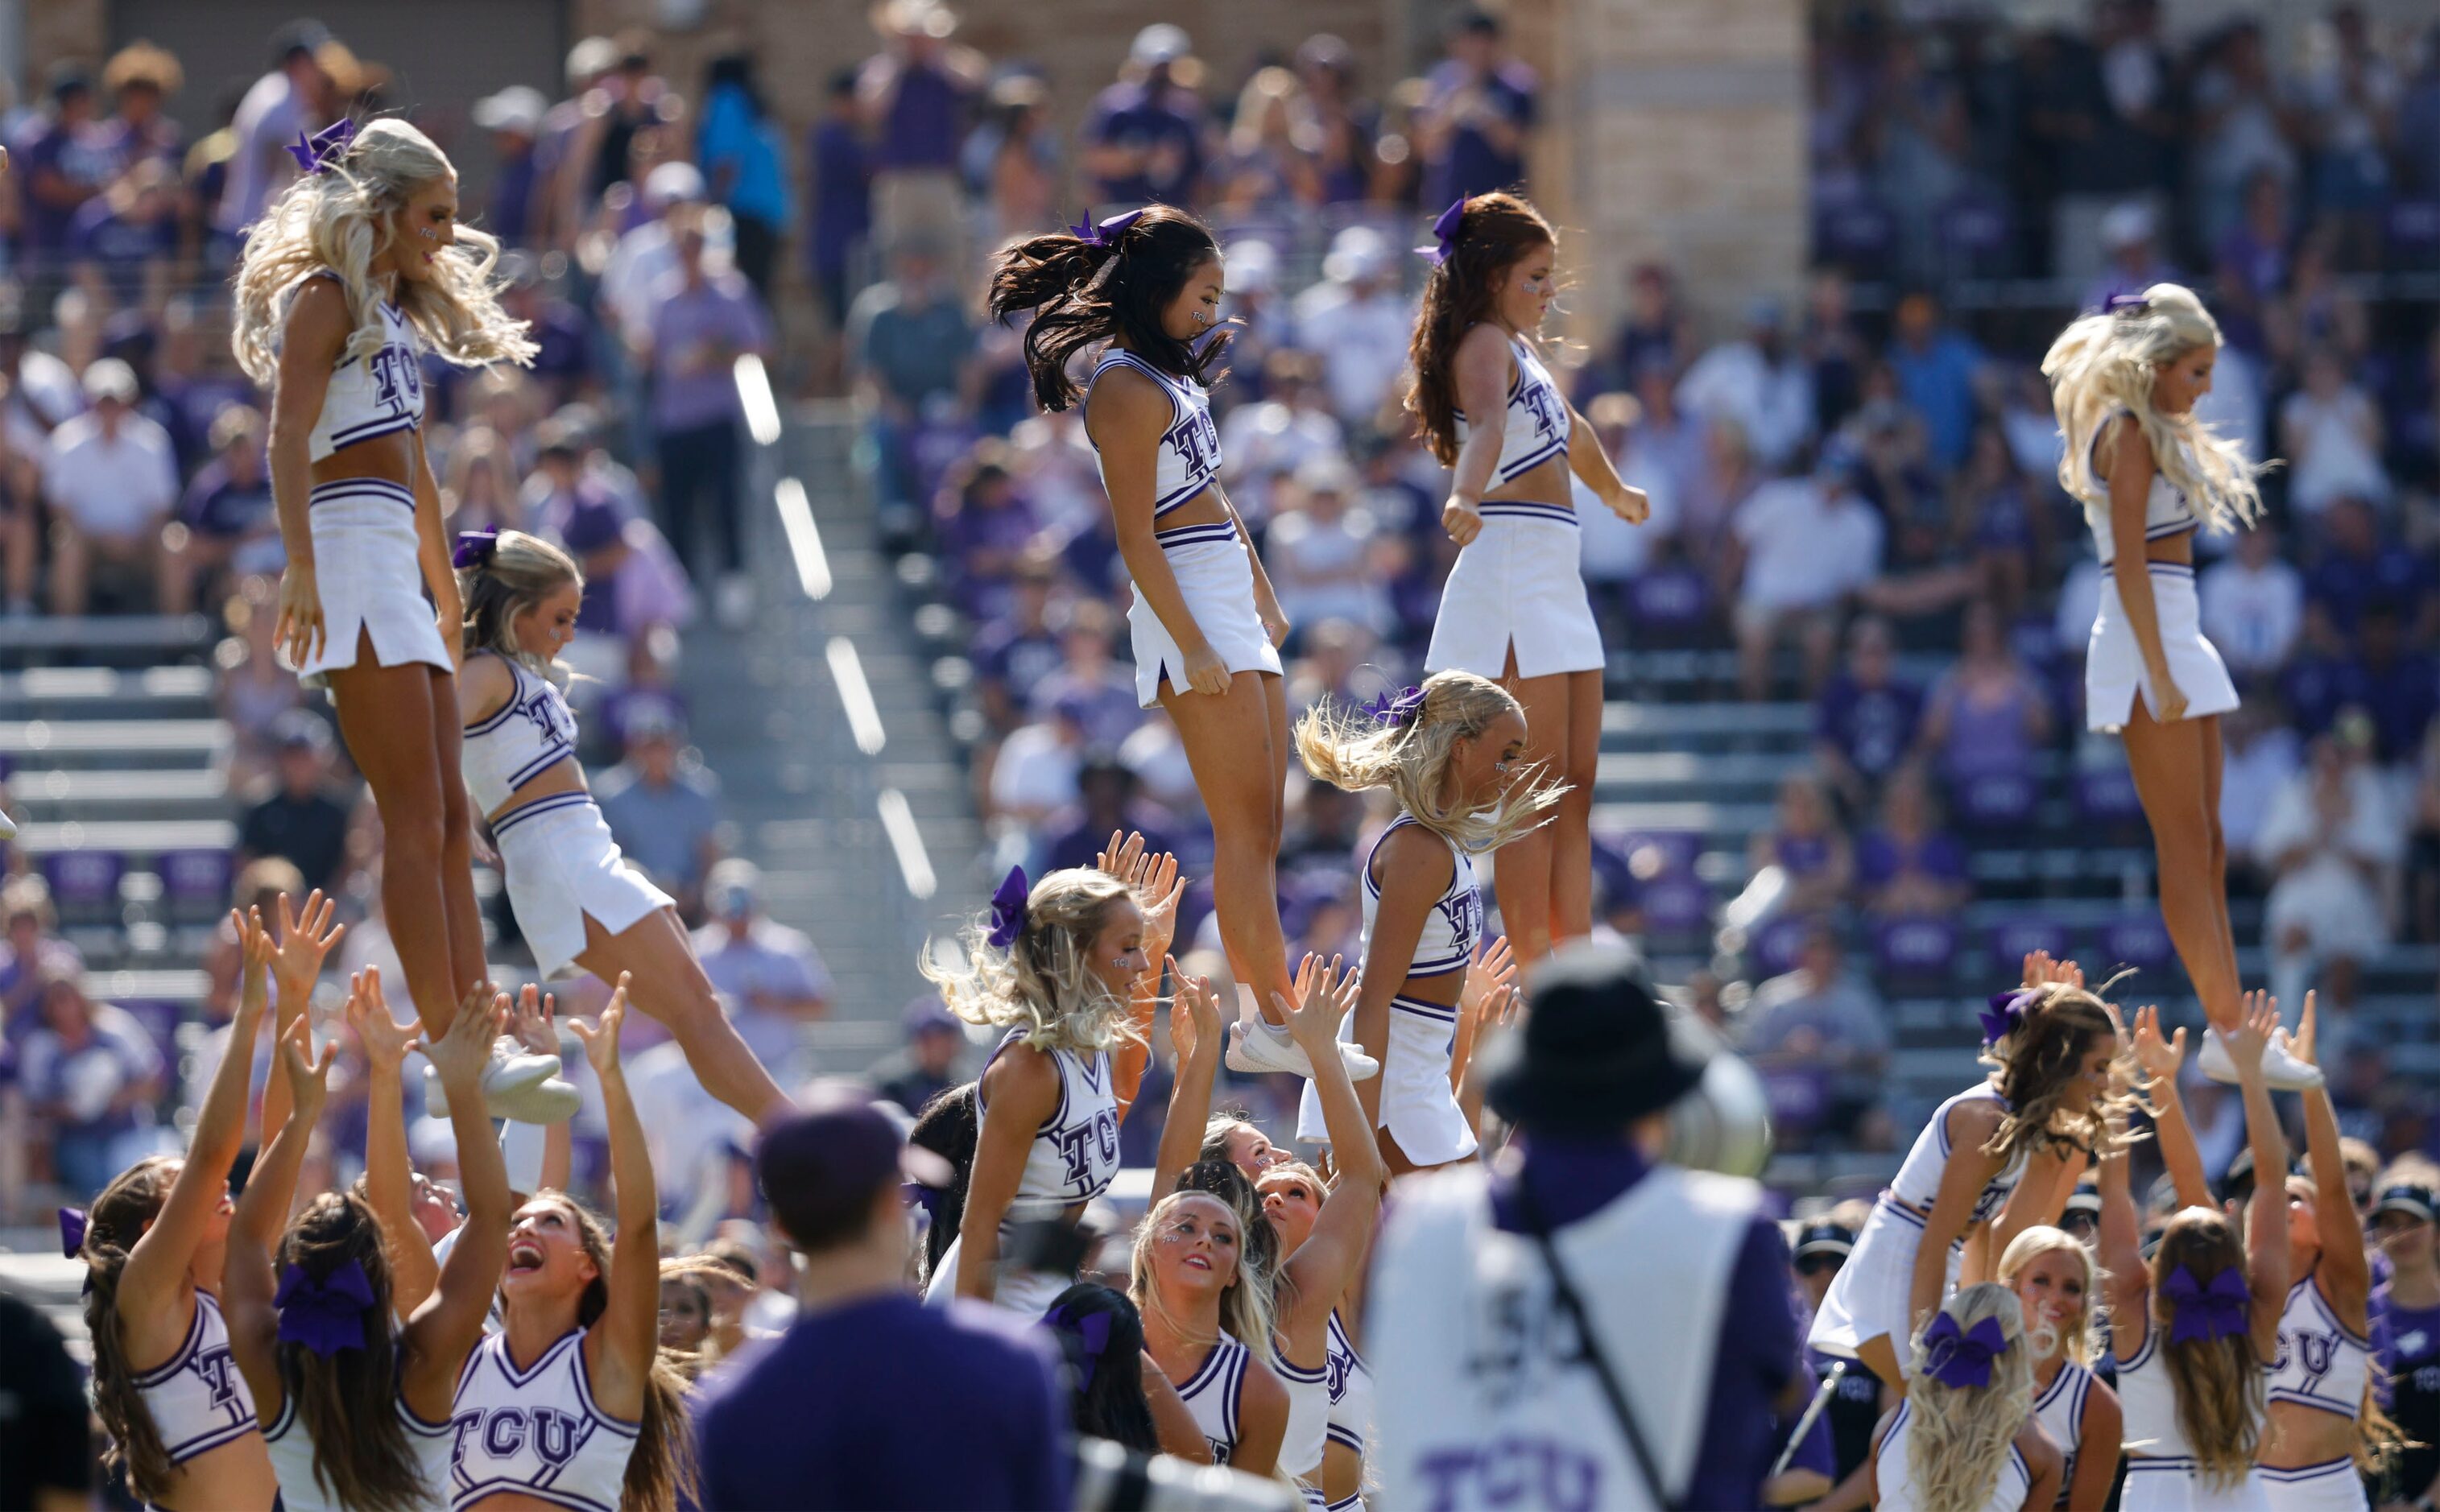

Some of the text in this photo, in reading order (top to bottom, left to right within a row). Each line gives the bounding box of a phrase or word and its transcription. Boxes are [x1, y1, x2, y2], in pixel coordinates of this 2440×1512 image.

[1192, 311, 1206, 323] TCU
[373, 341, 420, 407] TC
[1173, 406, 1218, 481] TC
[1449, 885, 1483, 948] TC
[1059, 1108, 1119, 1185] TC
[452, 1407, 579, 1469] TCU
